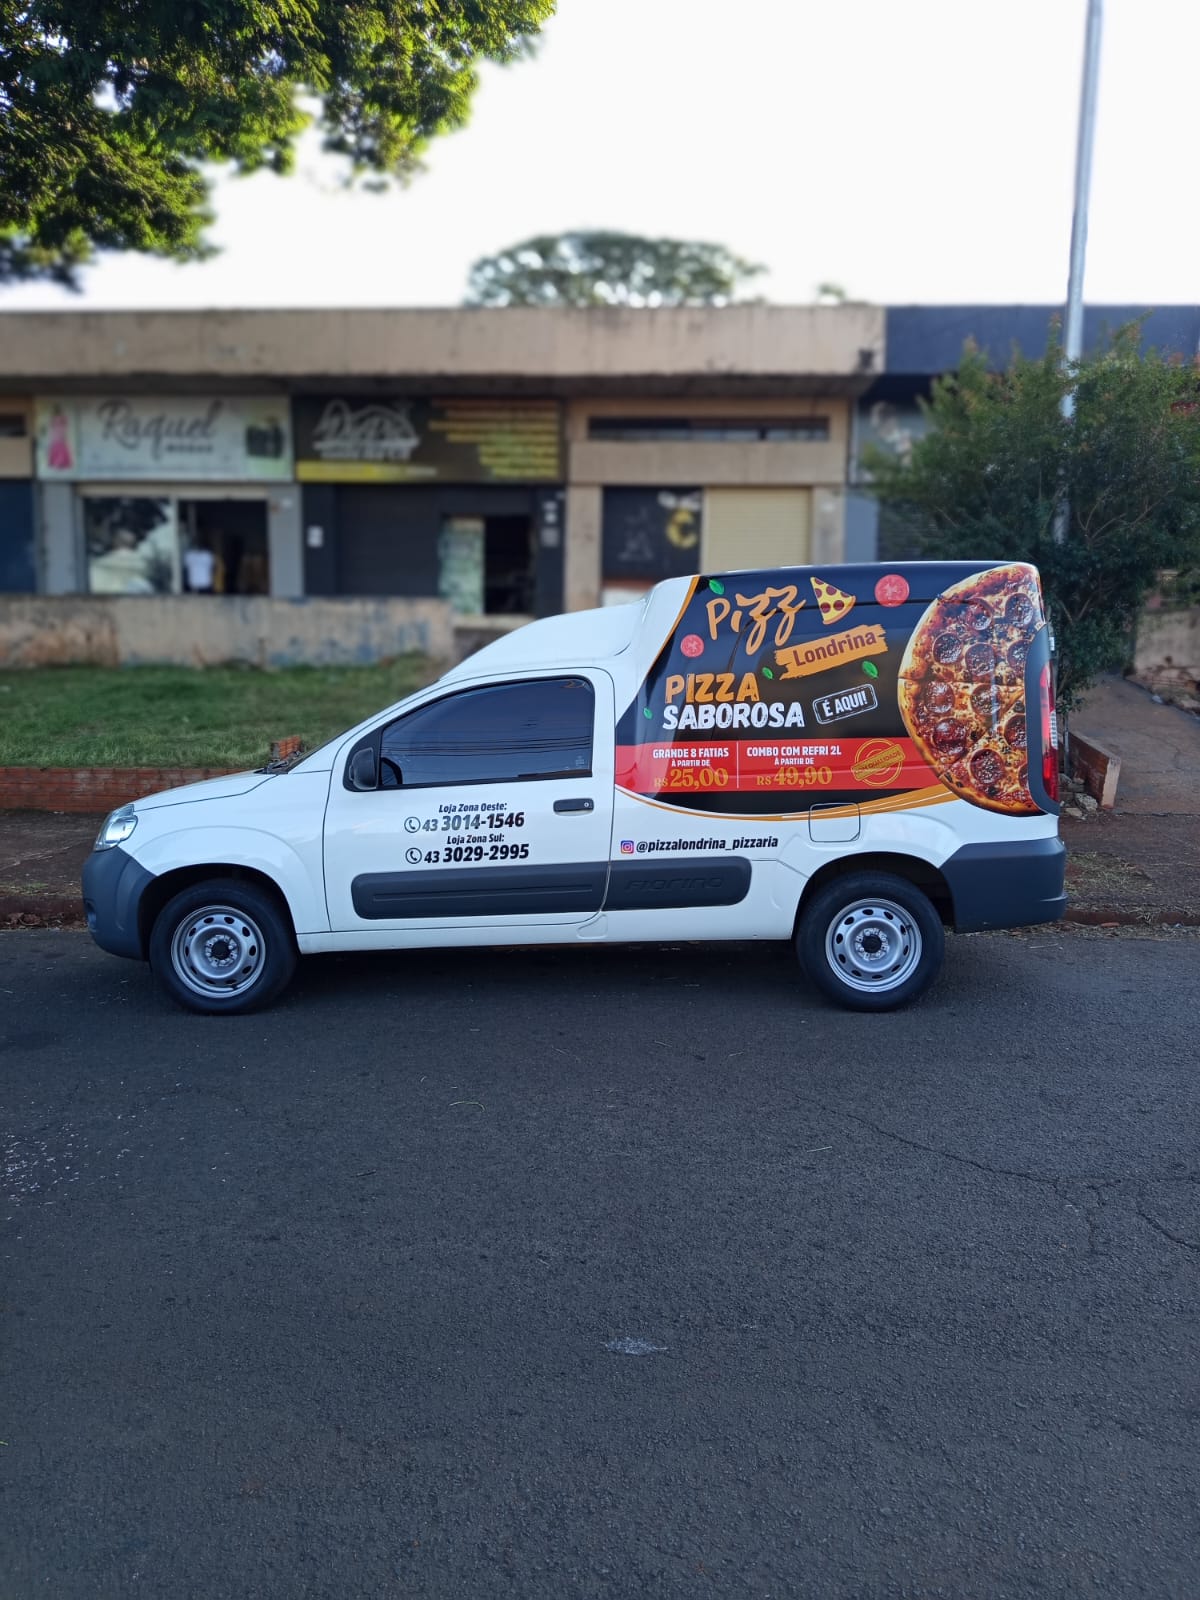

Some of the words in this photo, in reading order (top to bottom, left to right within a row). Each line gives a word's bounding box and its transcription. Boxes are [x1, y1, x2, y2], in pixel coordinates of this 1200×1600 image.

[793, 631, 877, 667] Londrina
[665, 672, 760, 704] PIZZA
[822, 700, 833, 717] É
[835, 690, 868, 712] AQUI!
[662, 701, 805, 730] SABOROSA
[653, 748, 689, 759] GRANDE
[690, 748, 697, 758] 8
[698, 747, 729, 758] FATIAS
[746, 746, 779, 757] COMBO
[781, 746, 801, 756] COM
[802, 746, 829, 756] REFRI
[830, 745, 842, 755] 2L
[780, 757, 804, 766] PARTIR
[805, 757, 815, 765] DE
[677, 759, 699, 767] PARTIR
[700, 759, 711, 767] DE
[670, 767, 729, 789] 25,00
[773, 766, 833, 787] 49,90
[438, 804, 458, 814] Loja
[458, 803, 479, 812] Zona
[480, 802, 508, 812] Oeste:
[422, 819, 438, 832] 43
[441, 811, 525, 831] 3014-1546
[446, 835, 465, 845] Loja
[466, 834, 487, 844] Zona
[488, 833, 505, 843] Sul:
[635, 835, 779, 854] @pizzalondrina_pizzaria
[424, 851, 440, 864] 43
[442, 843, 530, 863] 3029-2995
